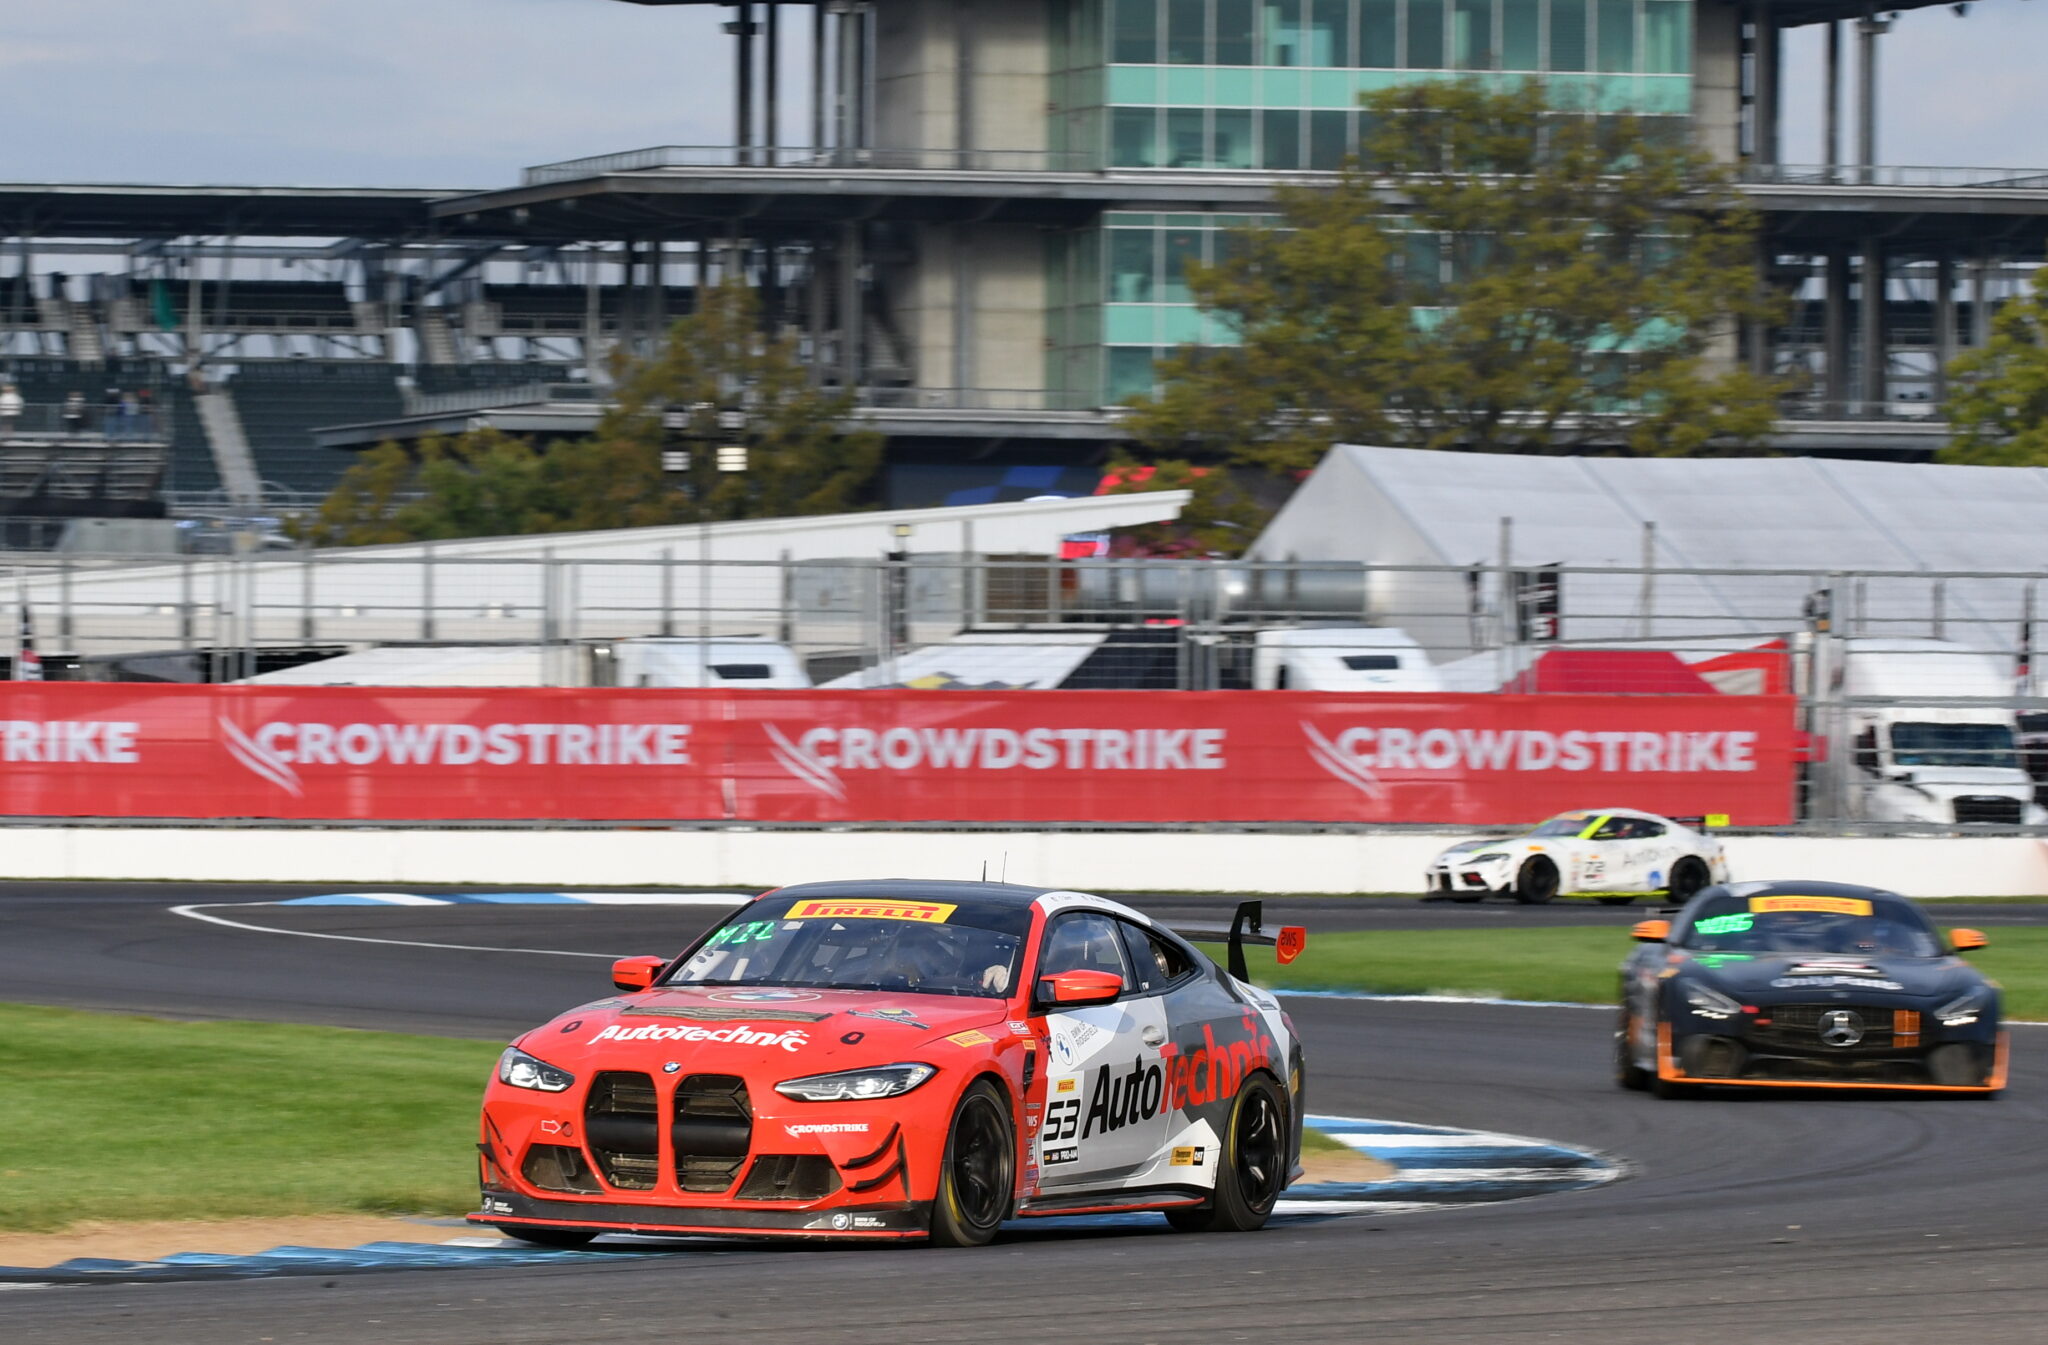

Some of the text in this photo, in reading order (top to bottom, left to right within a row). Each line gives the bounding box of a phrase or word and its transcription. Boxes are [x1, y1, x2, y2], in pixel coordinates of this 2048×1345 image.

[0, 720, 139, 763] RIKE
[259, 722, 690, 765] CROWDSTRIKE
[803, 727, 1226, 770] CROWDSTRIKE
[1336, 727, 1757, 772] CROWDSTRIKE
[800, 903, 940, 919] PIRELLI
[586, 1024, 811, 1053] AutoTechnic
[791, 1123, 869, 1134] CROWDSTRIKE
[1043, 1099, 1081, 1142] 53
